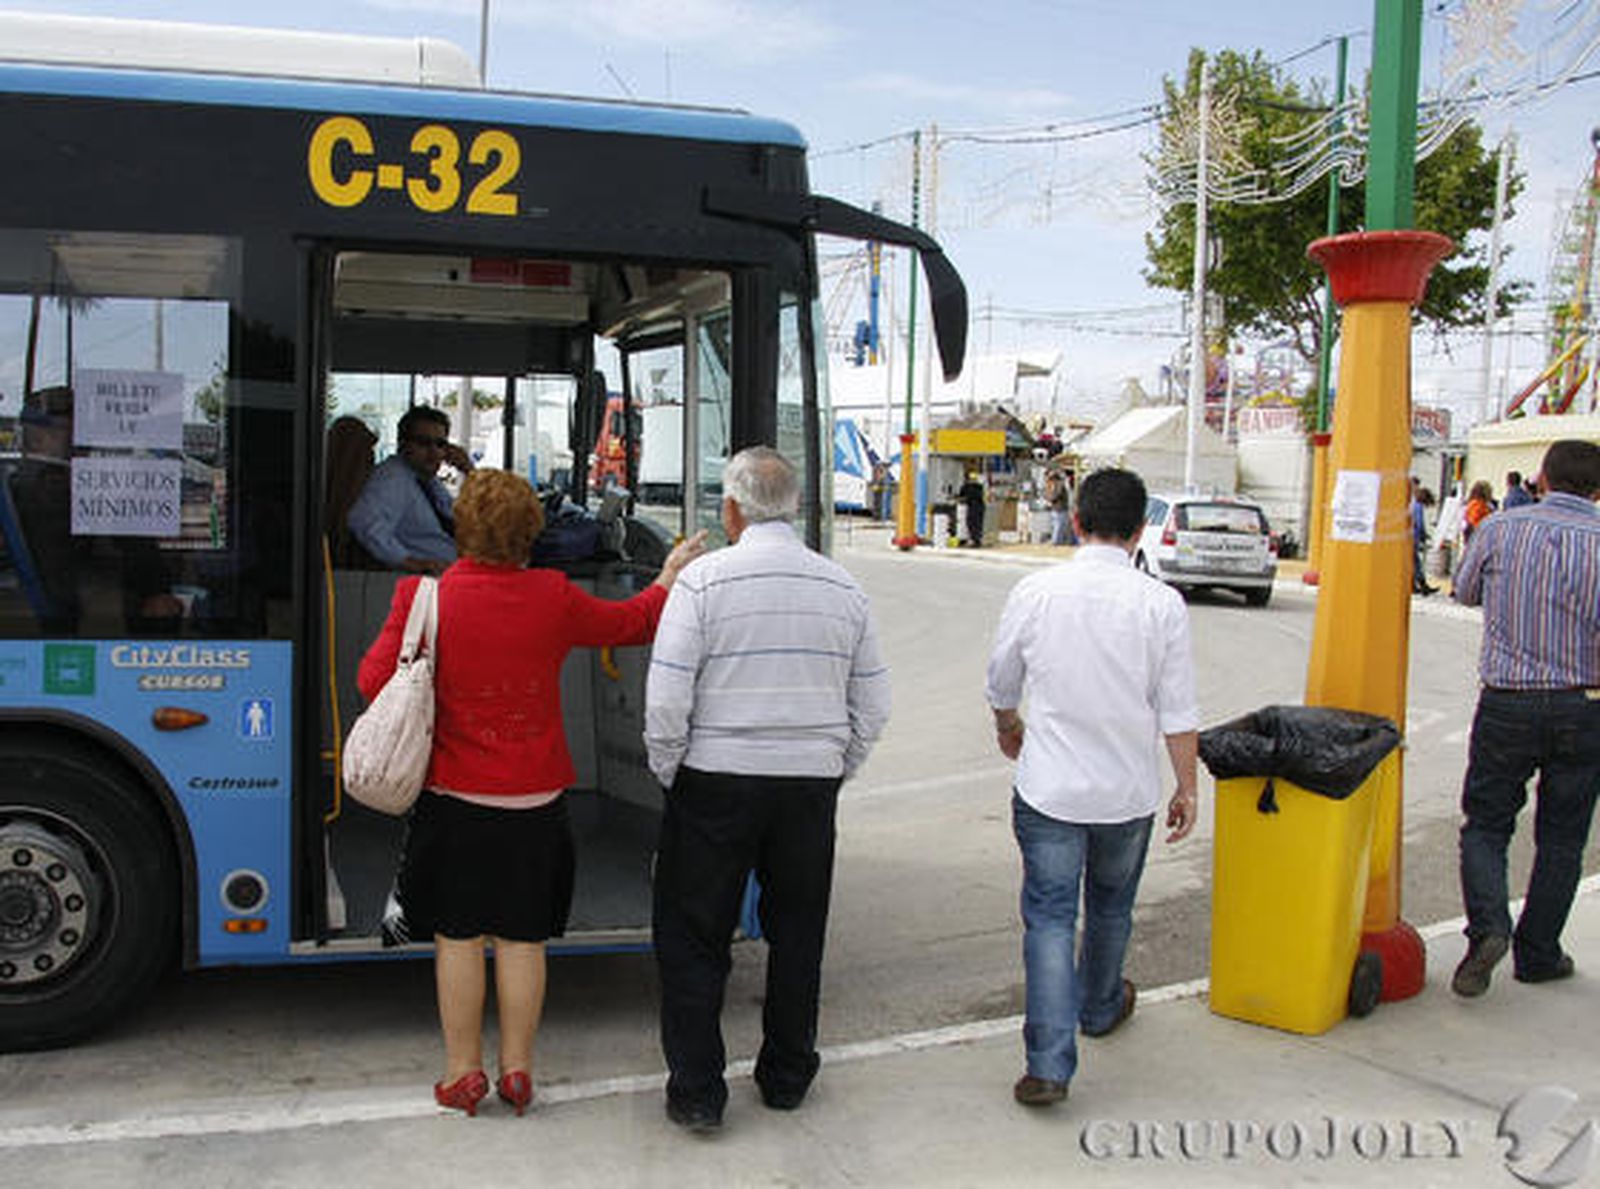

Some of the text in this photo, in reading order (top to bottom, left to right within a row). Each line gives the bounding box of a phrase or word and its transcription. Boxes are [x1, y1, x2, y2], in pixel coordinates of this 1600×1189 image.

[308, 116, 521, 216] C-32
[76, 468, 176, 492] SERVICIOS
[110, 644, 252, 669] CityClass
